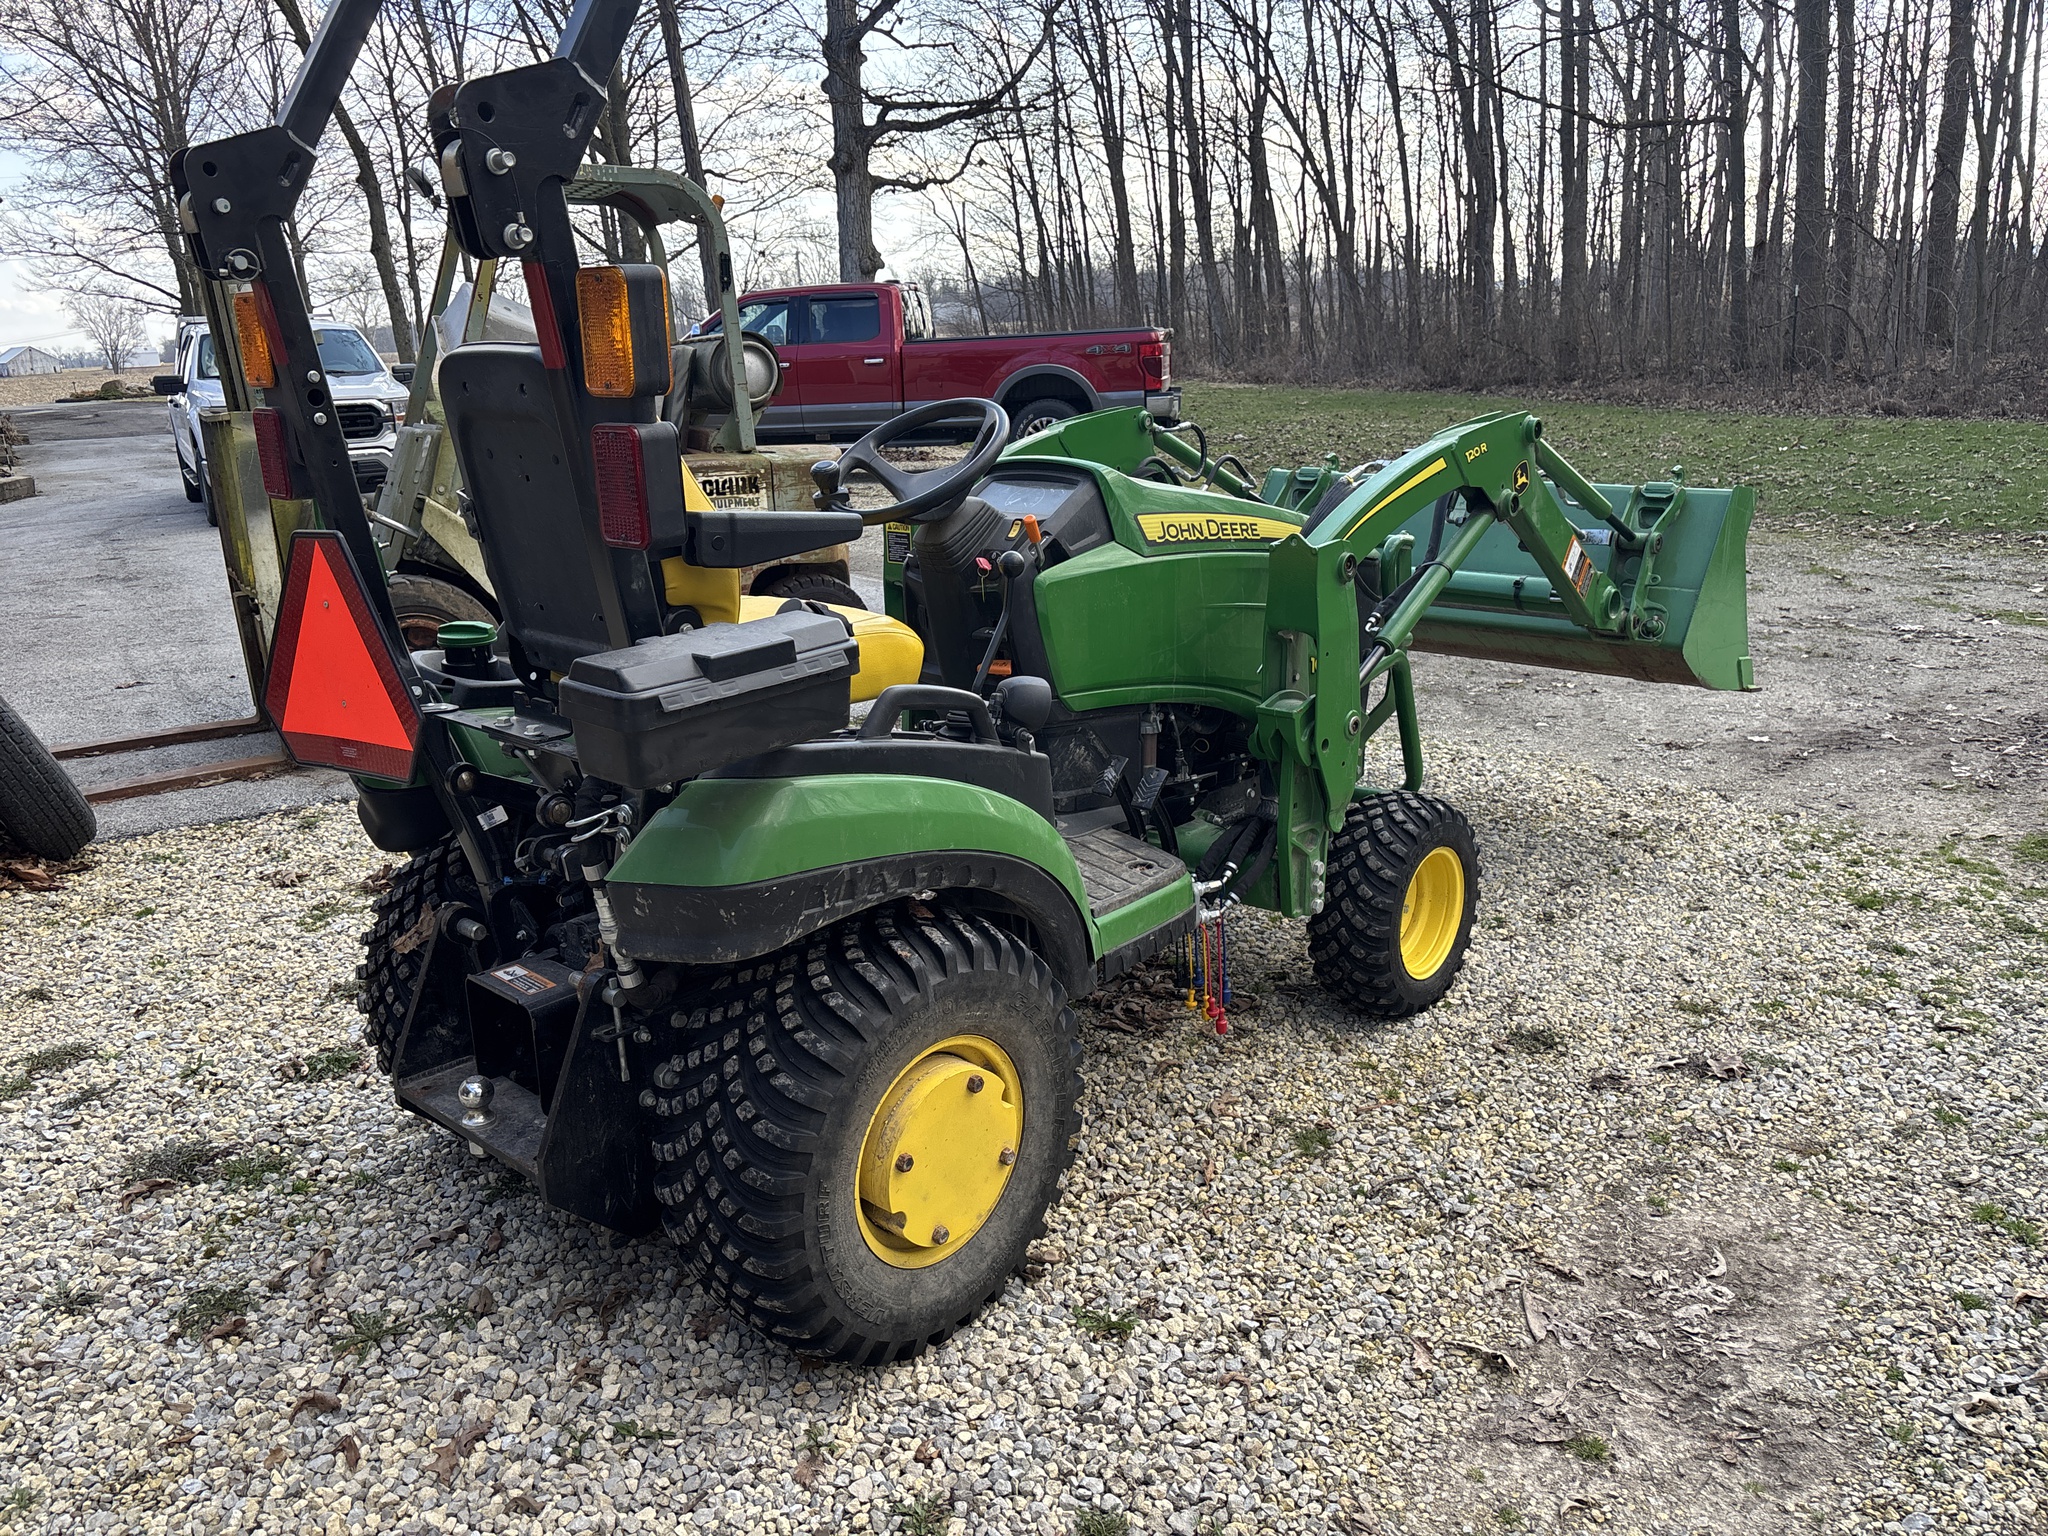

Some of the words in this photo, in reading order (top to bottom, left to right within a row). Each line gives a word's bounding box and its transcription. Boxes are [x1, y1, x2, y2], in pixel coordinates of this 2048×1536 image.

[702, 476, 760, 496] CLARK
[1156, 521, 1205, 541] JOHN
[1205, 519, 1261, 538] DEERE
[1010, 991, 1067, 1140] CARLISLE
[817, 1179, 835, 1264] TURF
